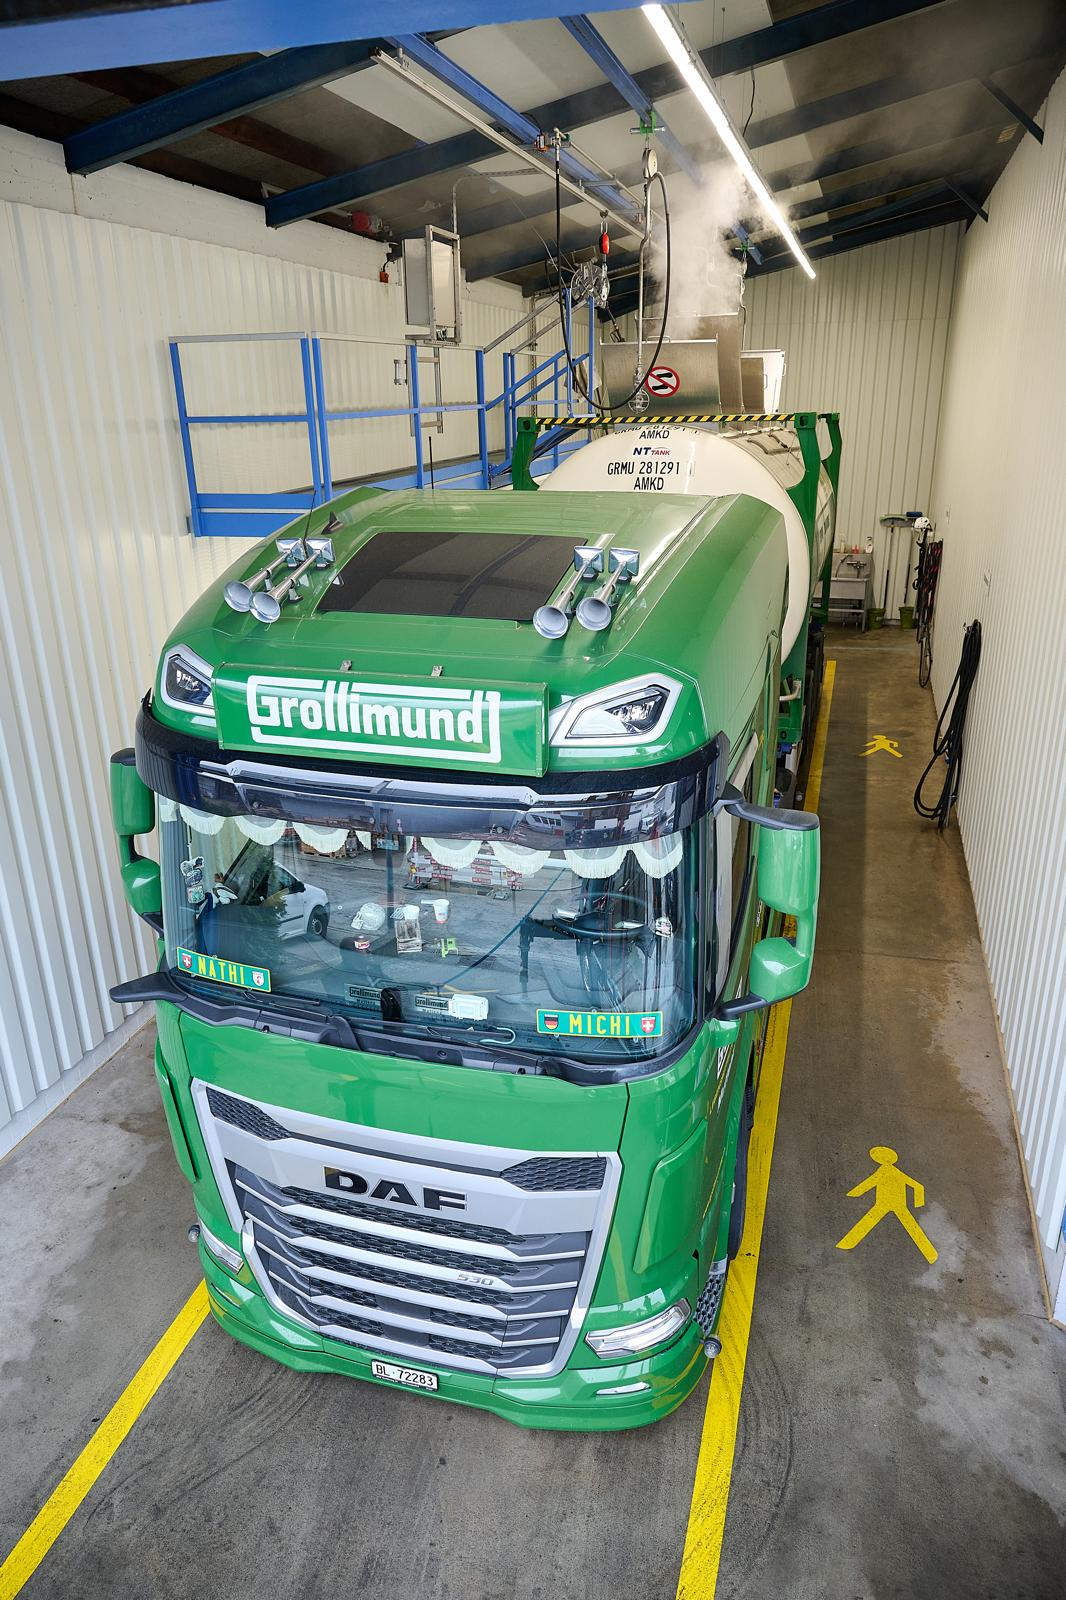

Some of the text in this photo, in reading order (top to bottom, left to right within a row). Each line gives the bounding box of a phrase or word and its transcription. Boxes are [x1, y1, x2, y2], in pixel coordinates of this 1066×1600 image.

[638, 430, 670, 440] AMKD
[632, 447, 651, 456] NT
[607, 461, 635, 476] GRMU
[639, 461, 680, 475] 281291
[633, 476, 664, 491] AMKD
[247, 676, 494, 754] Grollimund
[197, 956, 245, 984] NATHI
[569, 1013, 630, 1036] MICHI
[323, 1165, 467, 1212] DAF
[457, 1273, 495, 1287] 530
[375, 1363, 391, 1377] BL
[397, 1369, 434, 1386] 72283
